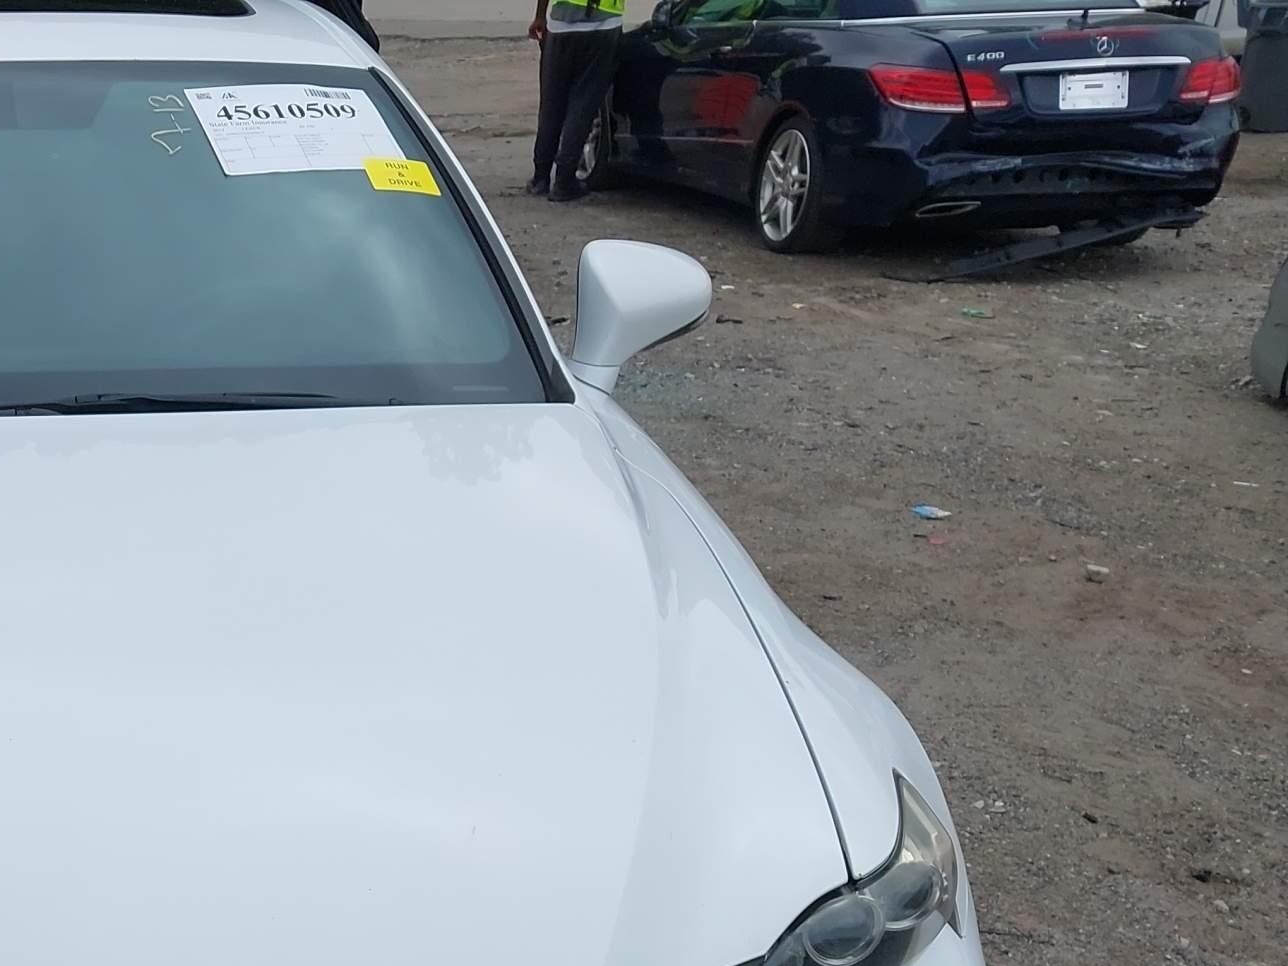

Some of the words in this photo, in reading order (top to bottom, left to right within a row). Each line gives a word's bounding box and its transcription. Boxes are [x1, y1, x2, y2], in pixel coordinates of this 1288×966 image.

[216, 102, 356, 121] 45610509
[384, 161, 409, 170] RUN
[387, 177, 422, 188] DRIVE
